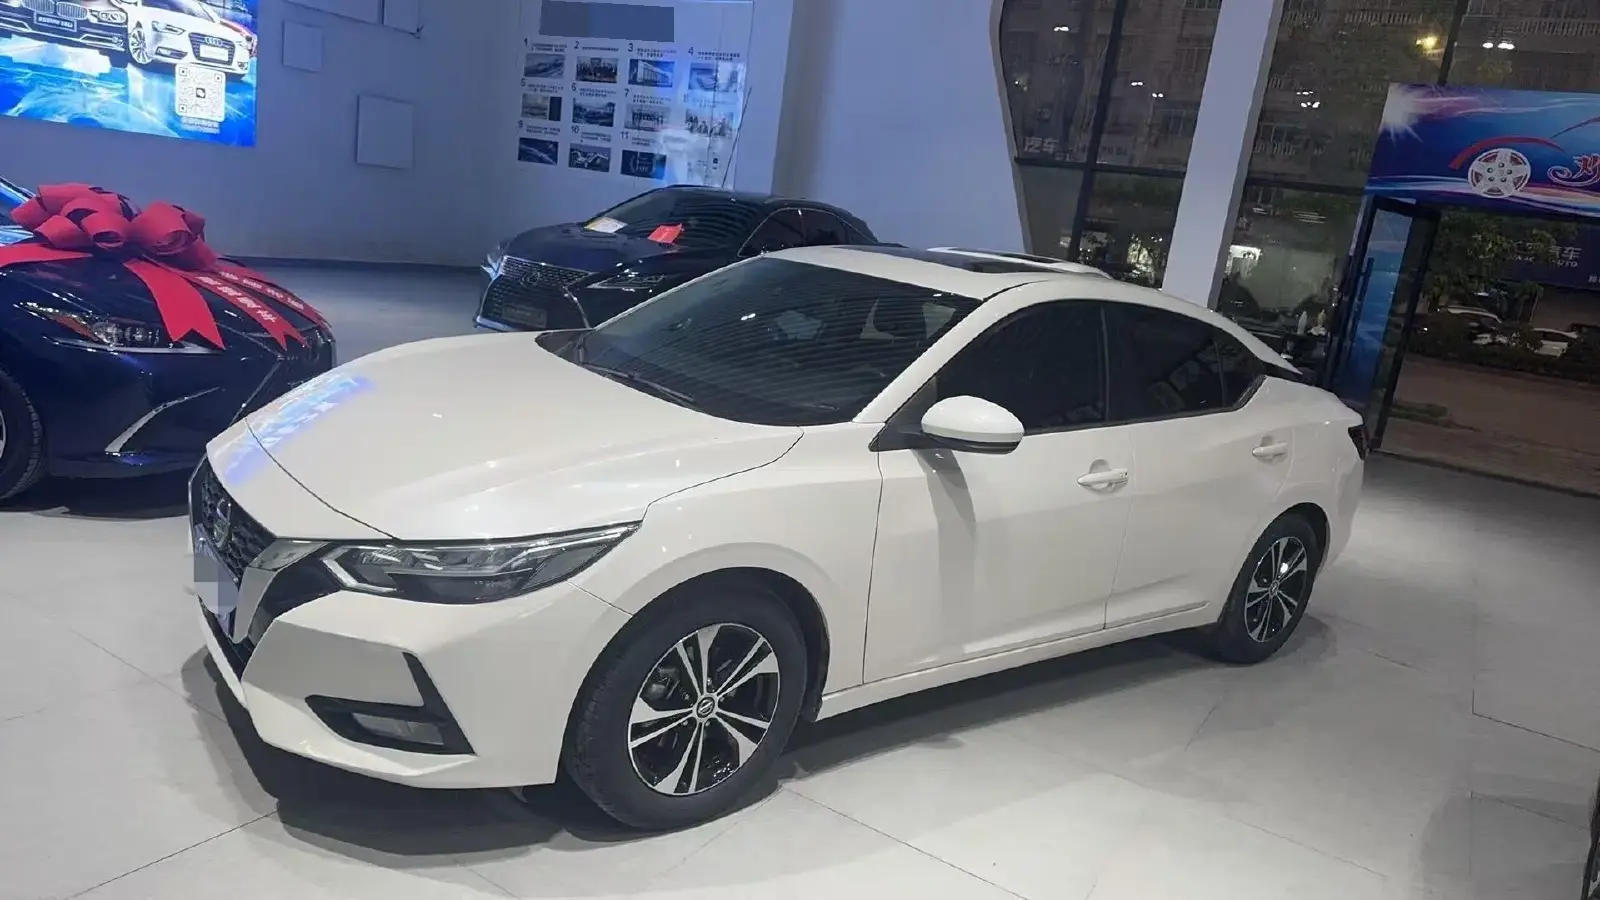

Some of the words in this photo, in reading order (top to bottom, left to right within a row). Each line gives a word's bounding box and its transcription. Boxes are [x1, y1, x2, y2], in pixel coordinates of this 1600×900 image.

[574, 41, 580, 49] 2
[627, 42, 634, 53] 3
[688, 46, 694, 55] 4
[520, 78, 526, 87] 5
[571, 83, 577, 92] 6
[624, 88, 630, 98] 7
[518, 120, 524, 128] 9
[571, 125, 580, 134] 10
[621, 131, 629, 140] 11
